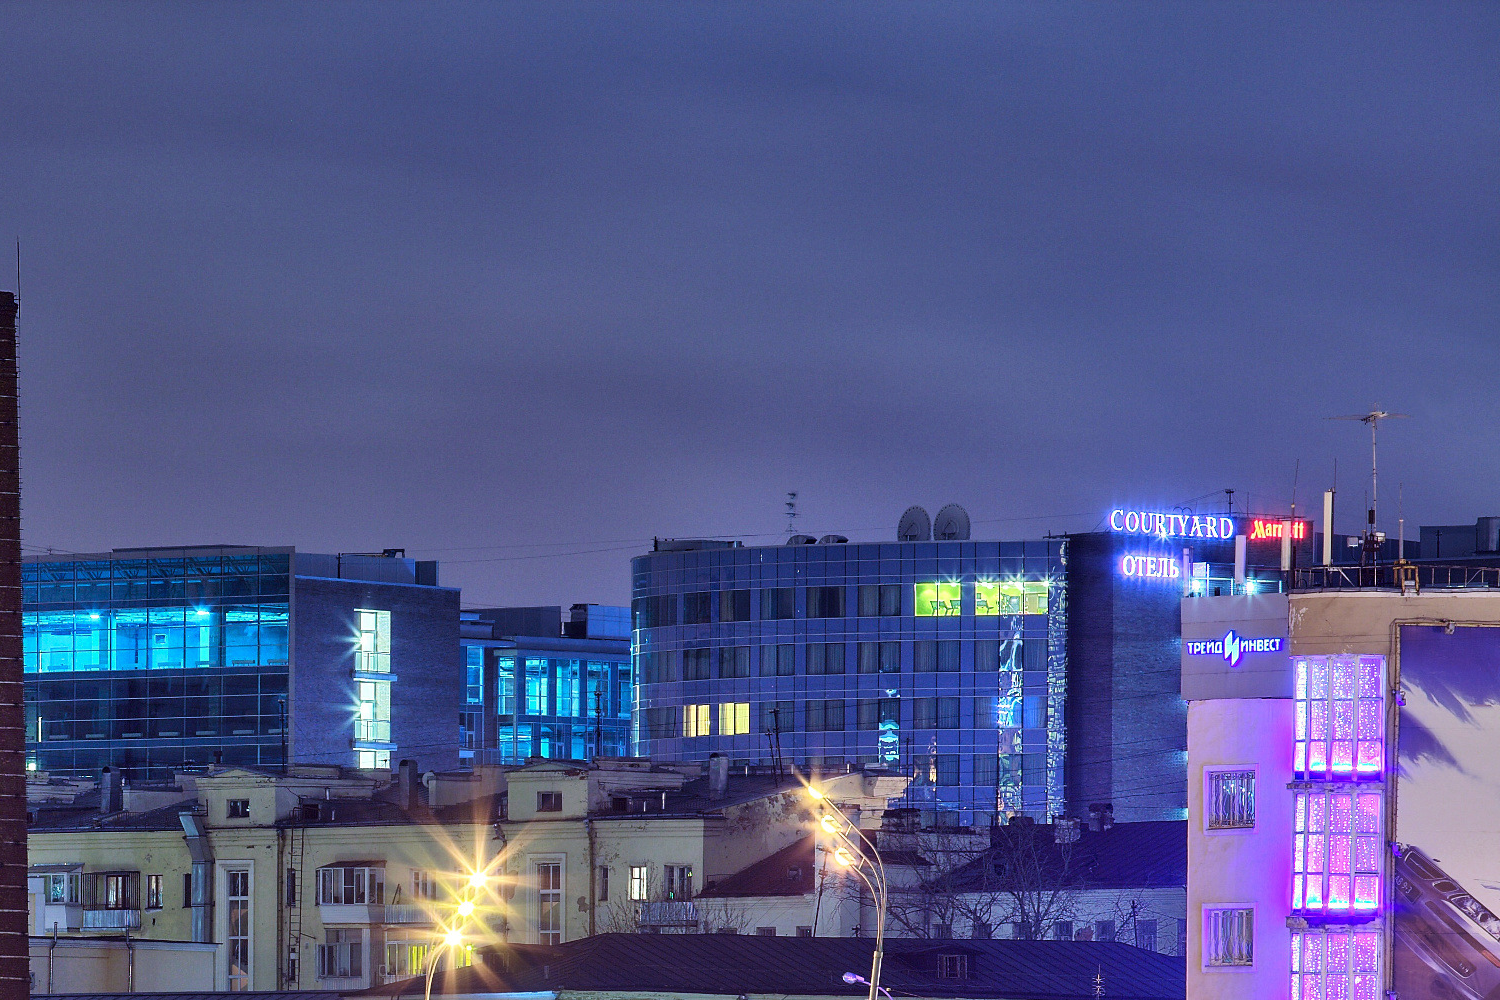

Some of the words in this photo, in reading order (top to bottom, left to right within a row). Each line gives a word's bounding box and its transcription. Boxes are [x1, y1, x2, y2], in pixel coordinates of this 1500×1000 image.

[1110, 509, 1234, 540] COURTYARD
[1251, 519, 1304, 539] Marrtt
[1122, 555, 1180, 578] ОТЕЛЬ
[1187, 639, 1223, 655] ТРЕЙД
[1240, 638, 1281, 652] ИНВЕСТ
